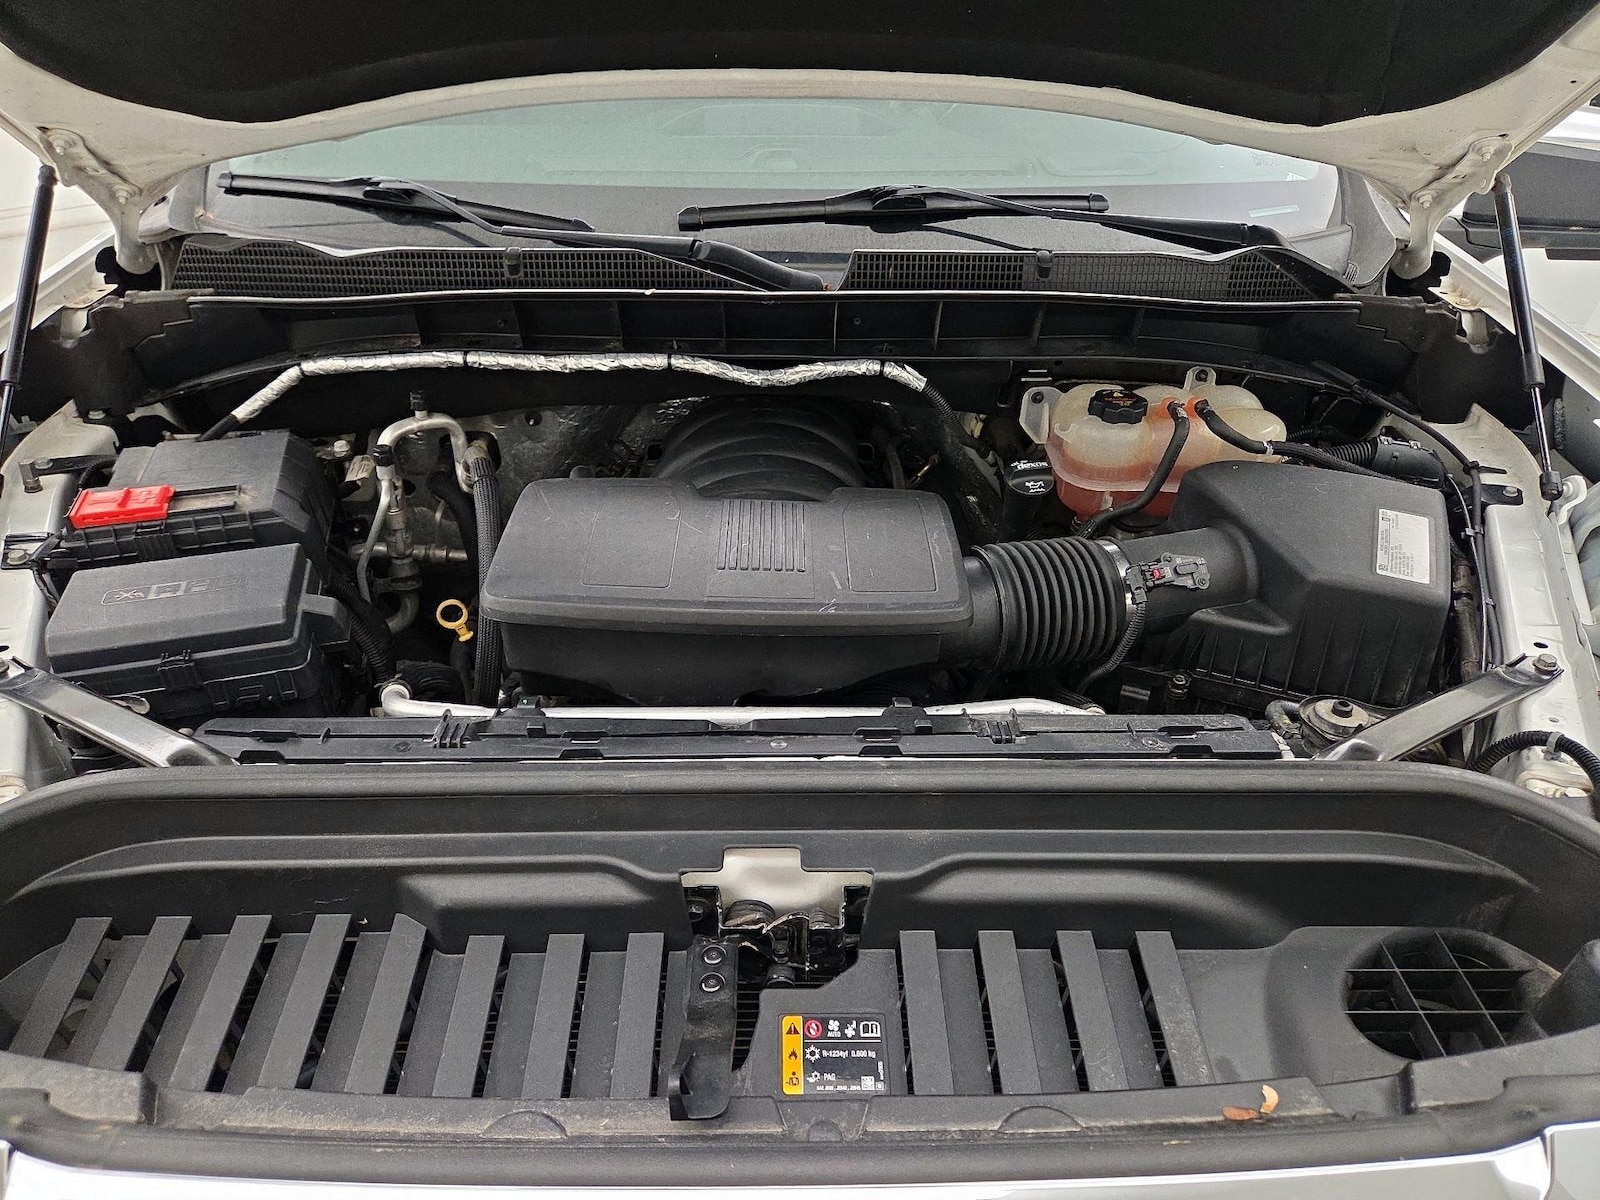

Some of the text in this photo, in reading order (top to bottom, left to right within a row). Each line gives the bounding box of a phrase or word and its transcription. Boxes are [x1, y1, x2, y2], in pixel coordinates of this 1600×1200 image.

[1017, 461, 1048, 470] dexos
[822, 1049, 849, 1059] R-1234yf
[868, 1049, 876, 1059] kg
